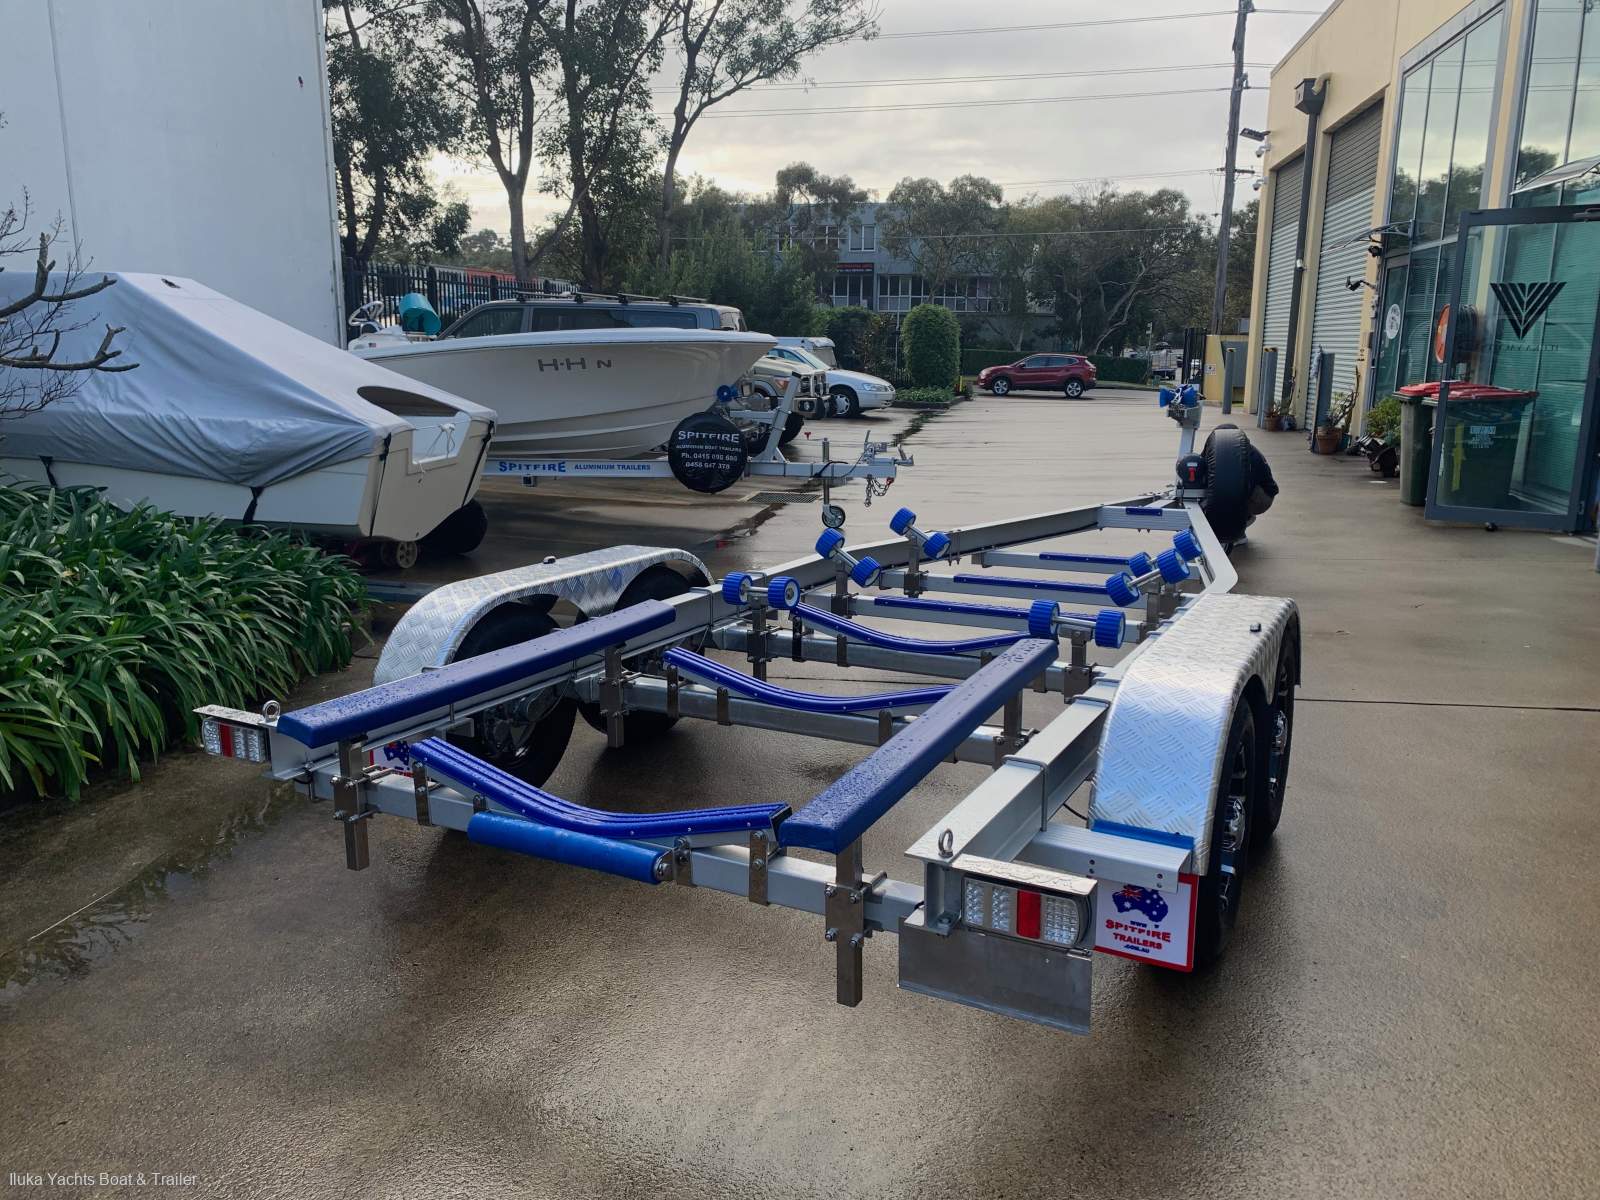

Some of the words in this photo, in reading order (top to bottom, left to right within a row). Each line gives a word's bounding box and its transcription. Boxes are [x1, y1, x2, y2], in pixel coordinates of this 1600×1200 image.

[678, 430, 740, 443] SPITFIRE
[499, 461, 566, 473] SPITFIRE
[1105, 919, 1172, 943] SPITFIRE
[1113, 932, 1163, 950] TRAILERS
